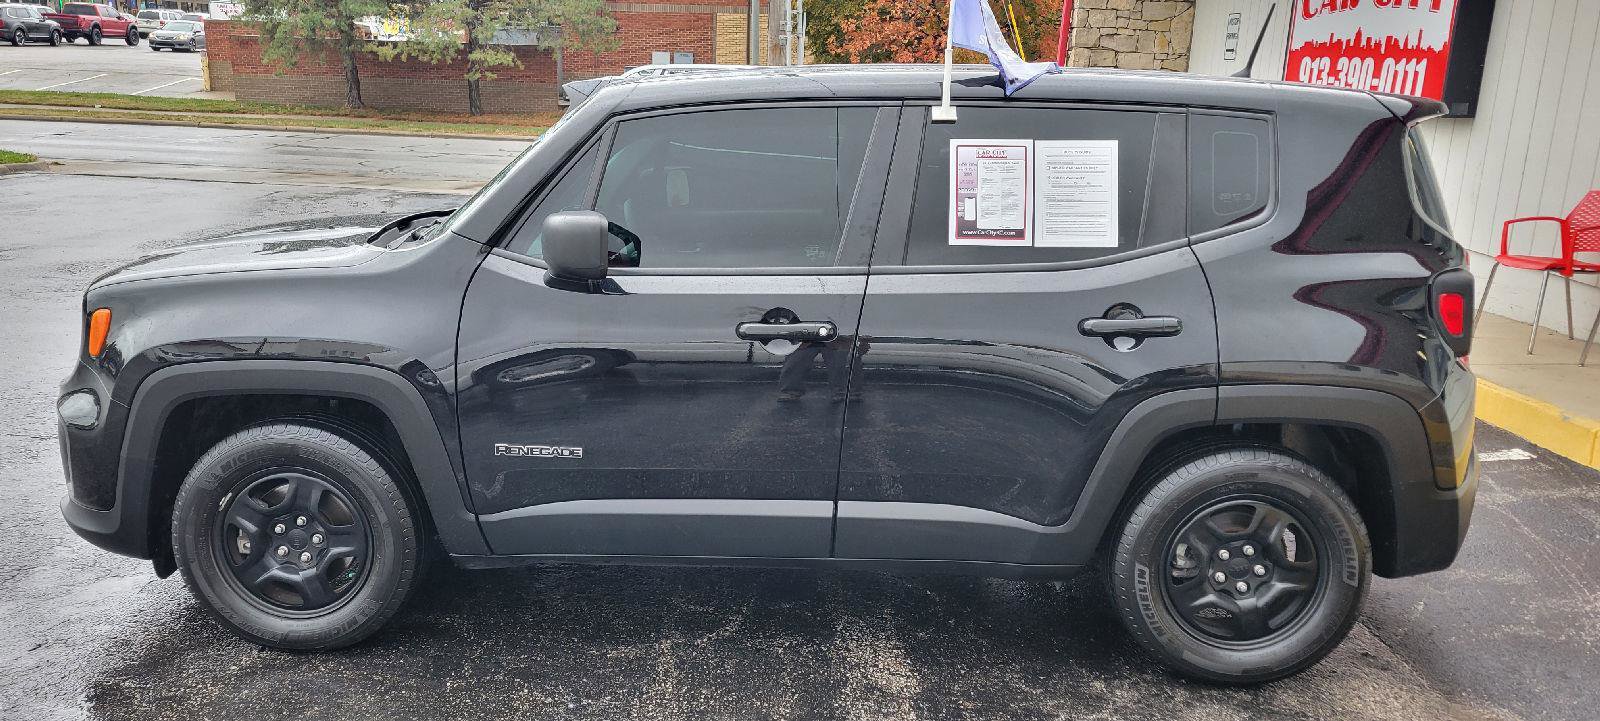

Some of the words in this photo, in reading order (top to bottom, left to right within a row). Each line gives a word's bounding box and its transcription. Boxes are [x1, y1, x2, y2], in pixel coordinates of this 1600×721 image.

[1300, 56, 1427, 97] 913-390-0111
[495, 444, 582, 458] RENEGADE
[1137, 567, 1168, 637] MICHELIN
